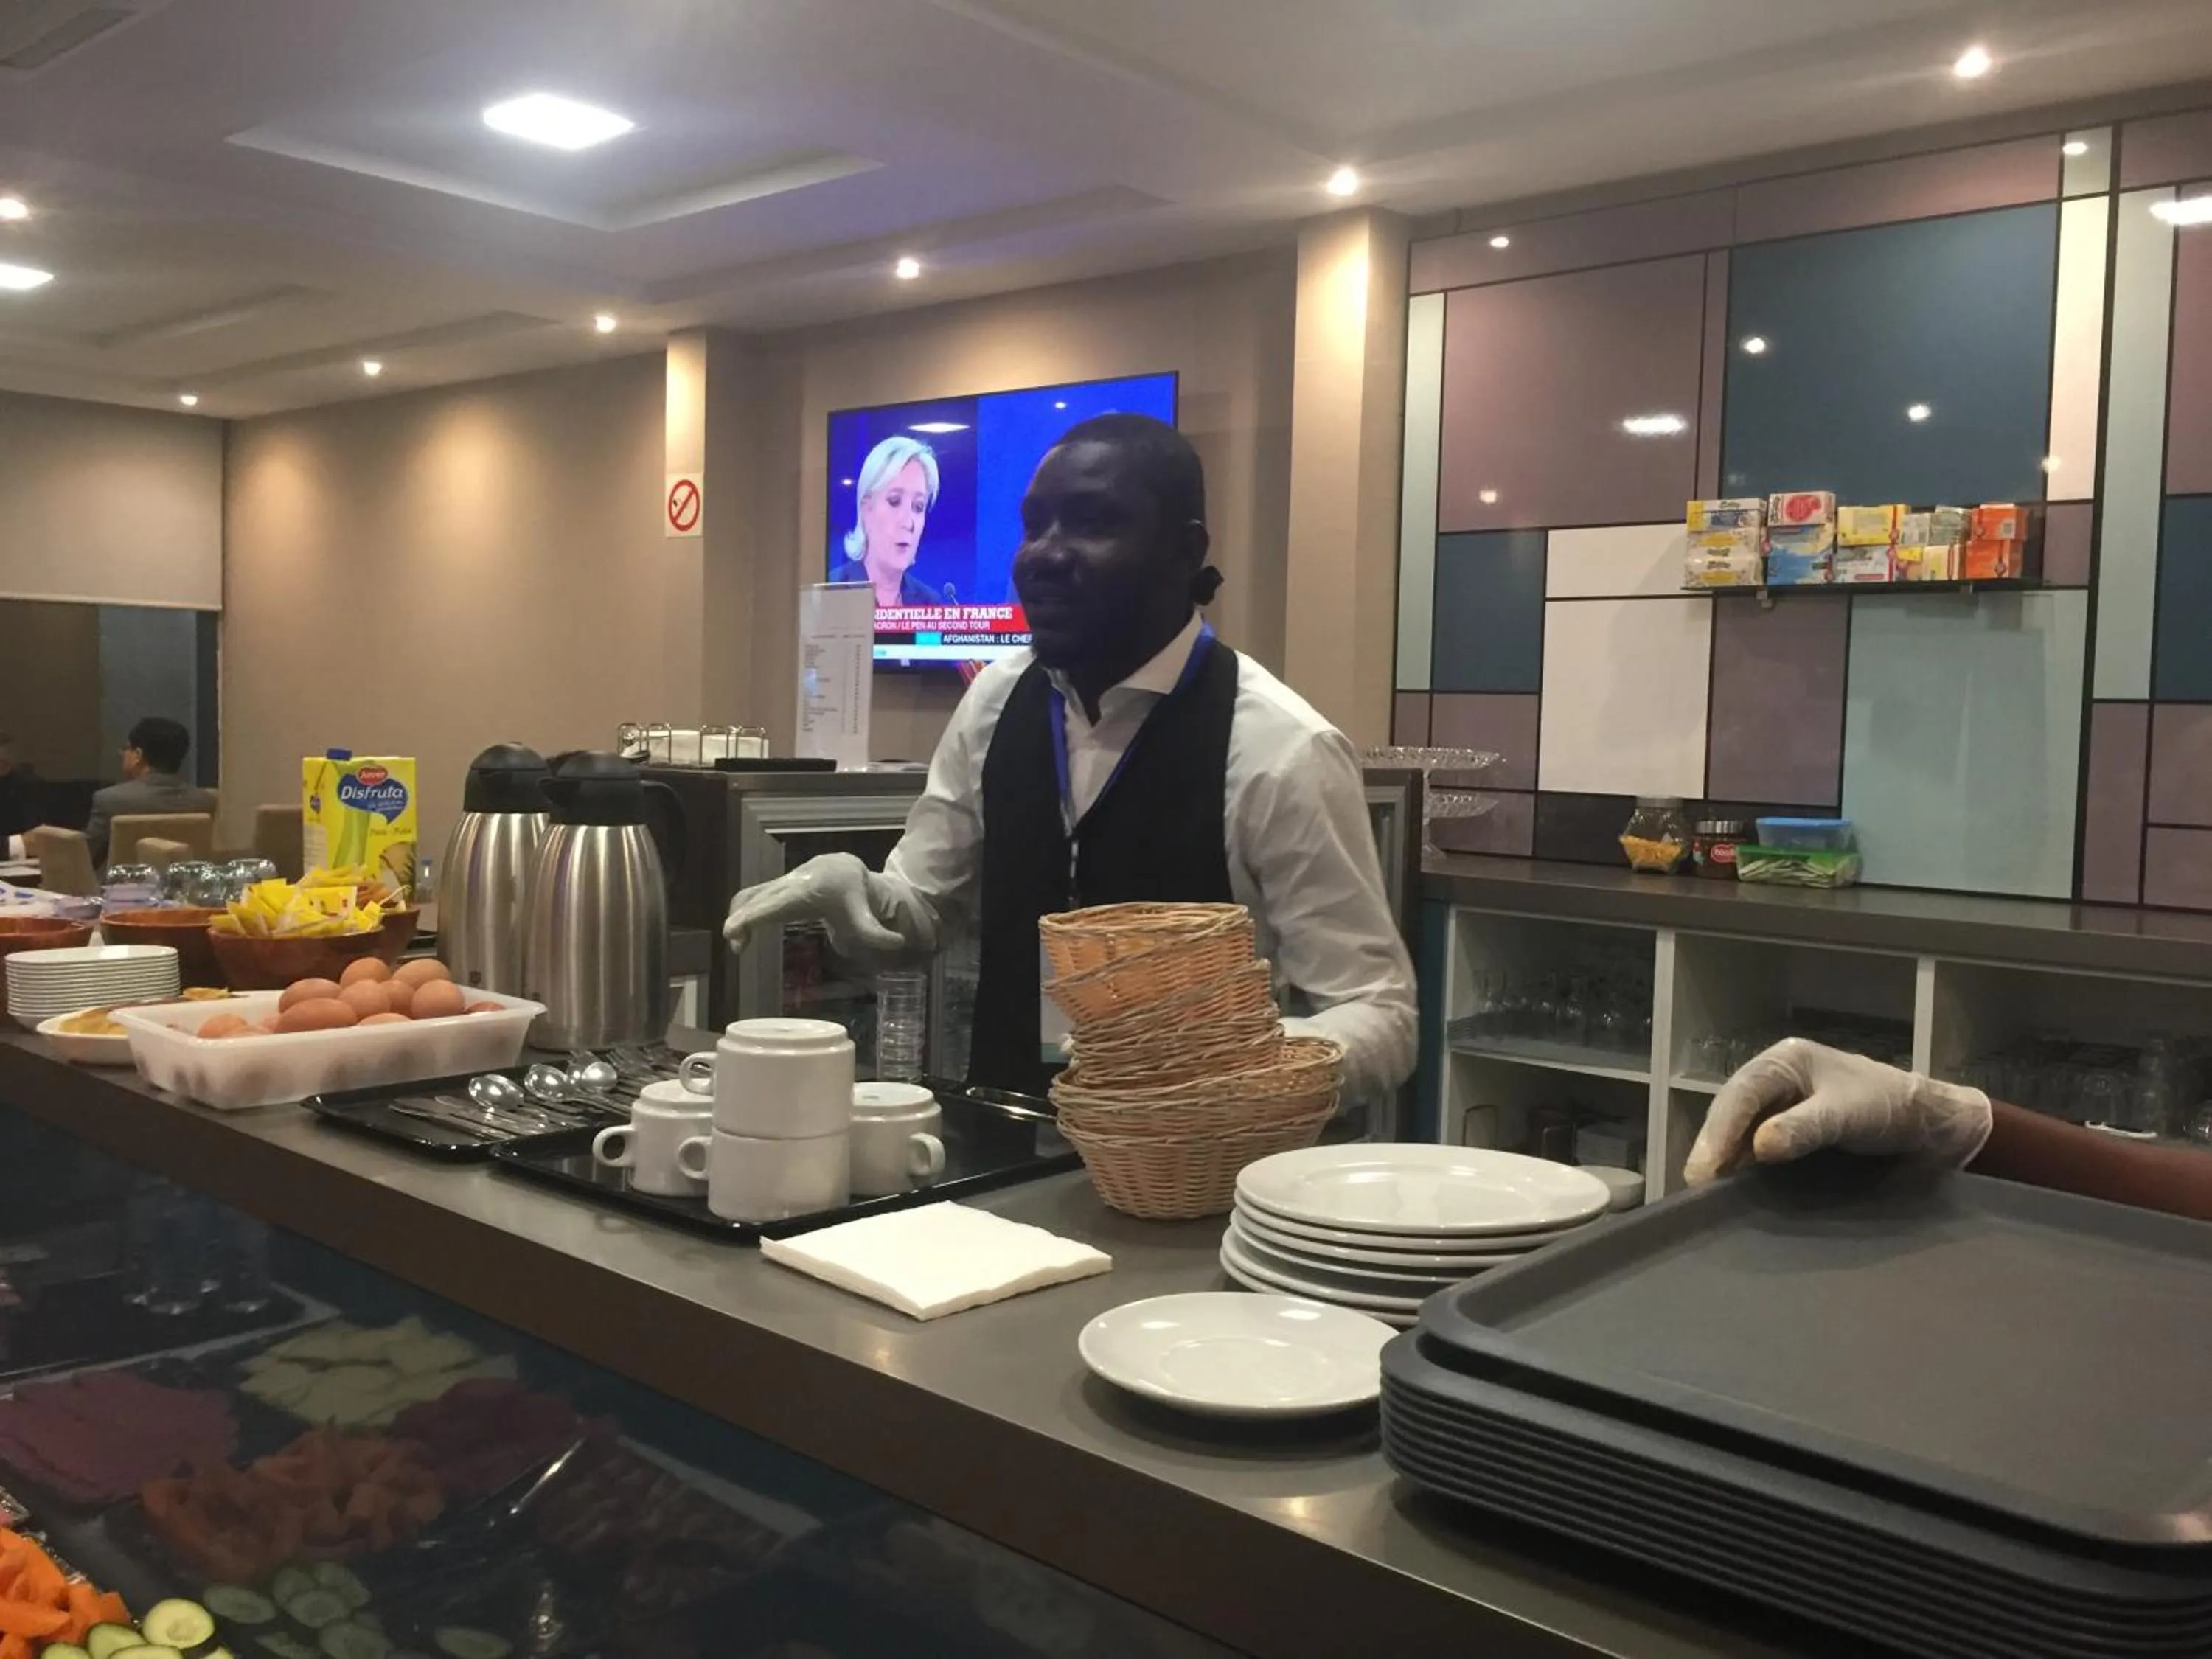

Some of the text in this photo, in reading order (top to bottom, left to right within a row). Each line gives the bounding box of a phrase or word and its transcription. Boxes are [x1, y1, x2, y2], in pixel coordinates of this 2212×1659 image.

[874, 607, 1012, 620] IDENTIELLE EN FRANCE
[911, 620, 926, 630] PEN
[928, 620, 937, 630] AU
[938, 620, 968, 630] SECOND
[969, 620, 991, 630] TOUR
[943, 633, 995, 644] AFGHANISTAN
[1001, 633, 1010, 643] LE
[341, 785, 404, 800] Disfruta
